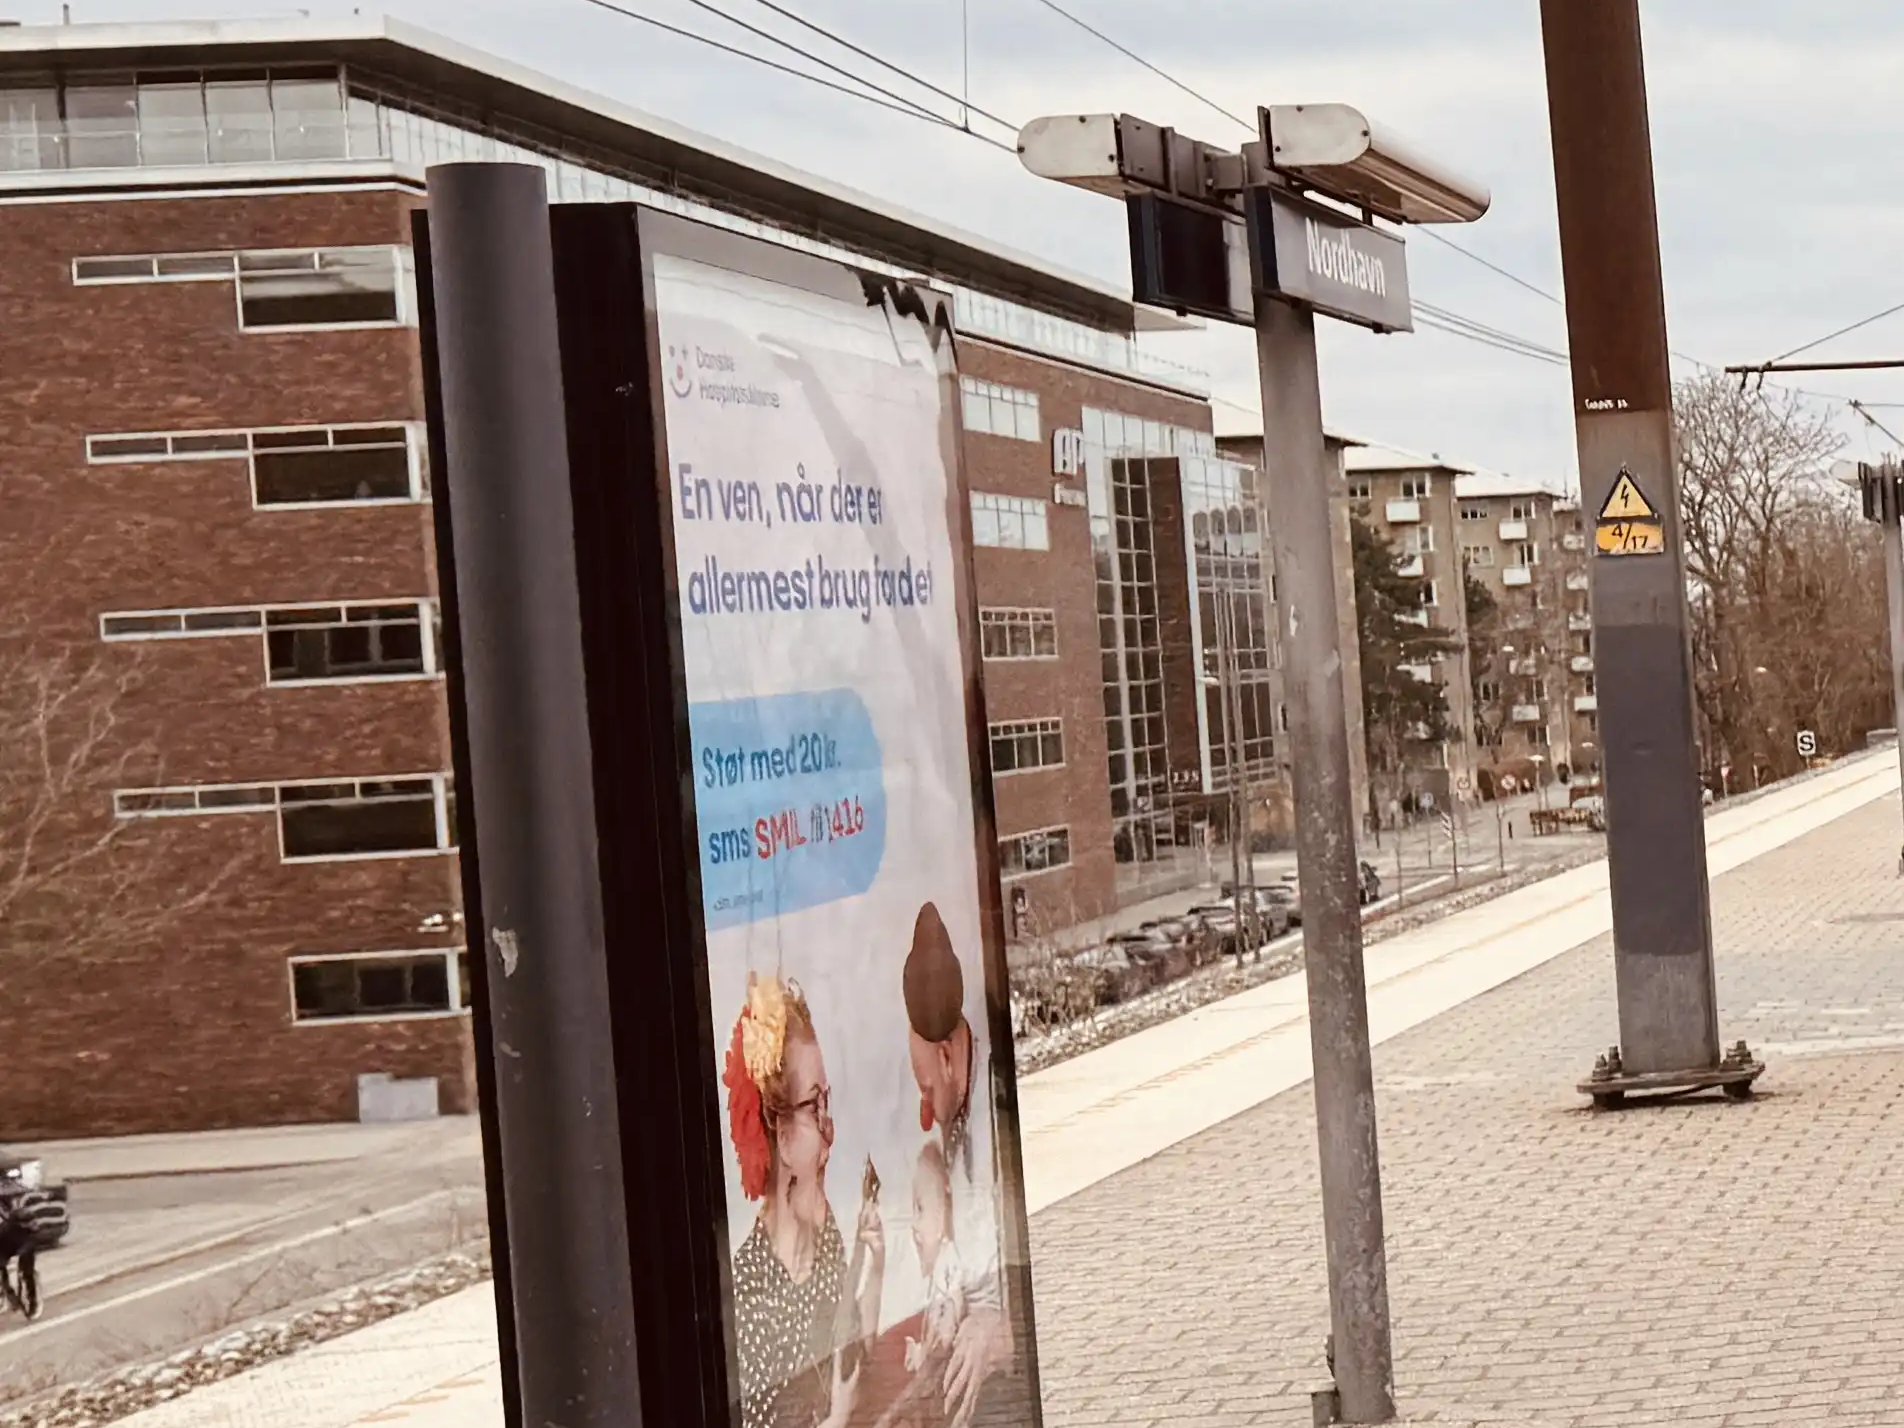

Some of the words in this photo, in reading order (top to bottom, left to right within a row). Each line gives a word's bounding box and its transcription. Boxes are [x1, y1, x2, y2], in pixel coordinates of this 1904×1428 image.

[1305, 217, 1386, 299] Nordhavn
[678, 462, 713, 521] En
[717, 476, 772, 529] ven,
[776, 461, 823, 523] når
[831, 467, 862, 524] der
[1611, 523, 1649, 550] 4/17
[688, 553, 814, 615] allermest
[818, 553, 871, 624] brug
[702, 746, 746, 789] Støt
[750, 734, 796, 781] med
[799, 732, 823, 774] 20
[1799, 734, 1814, 752] S
[708, 827, 751, 865] sms
[755, 808, 807, 860] SMIL
